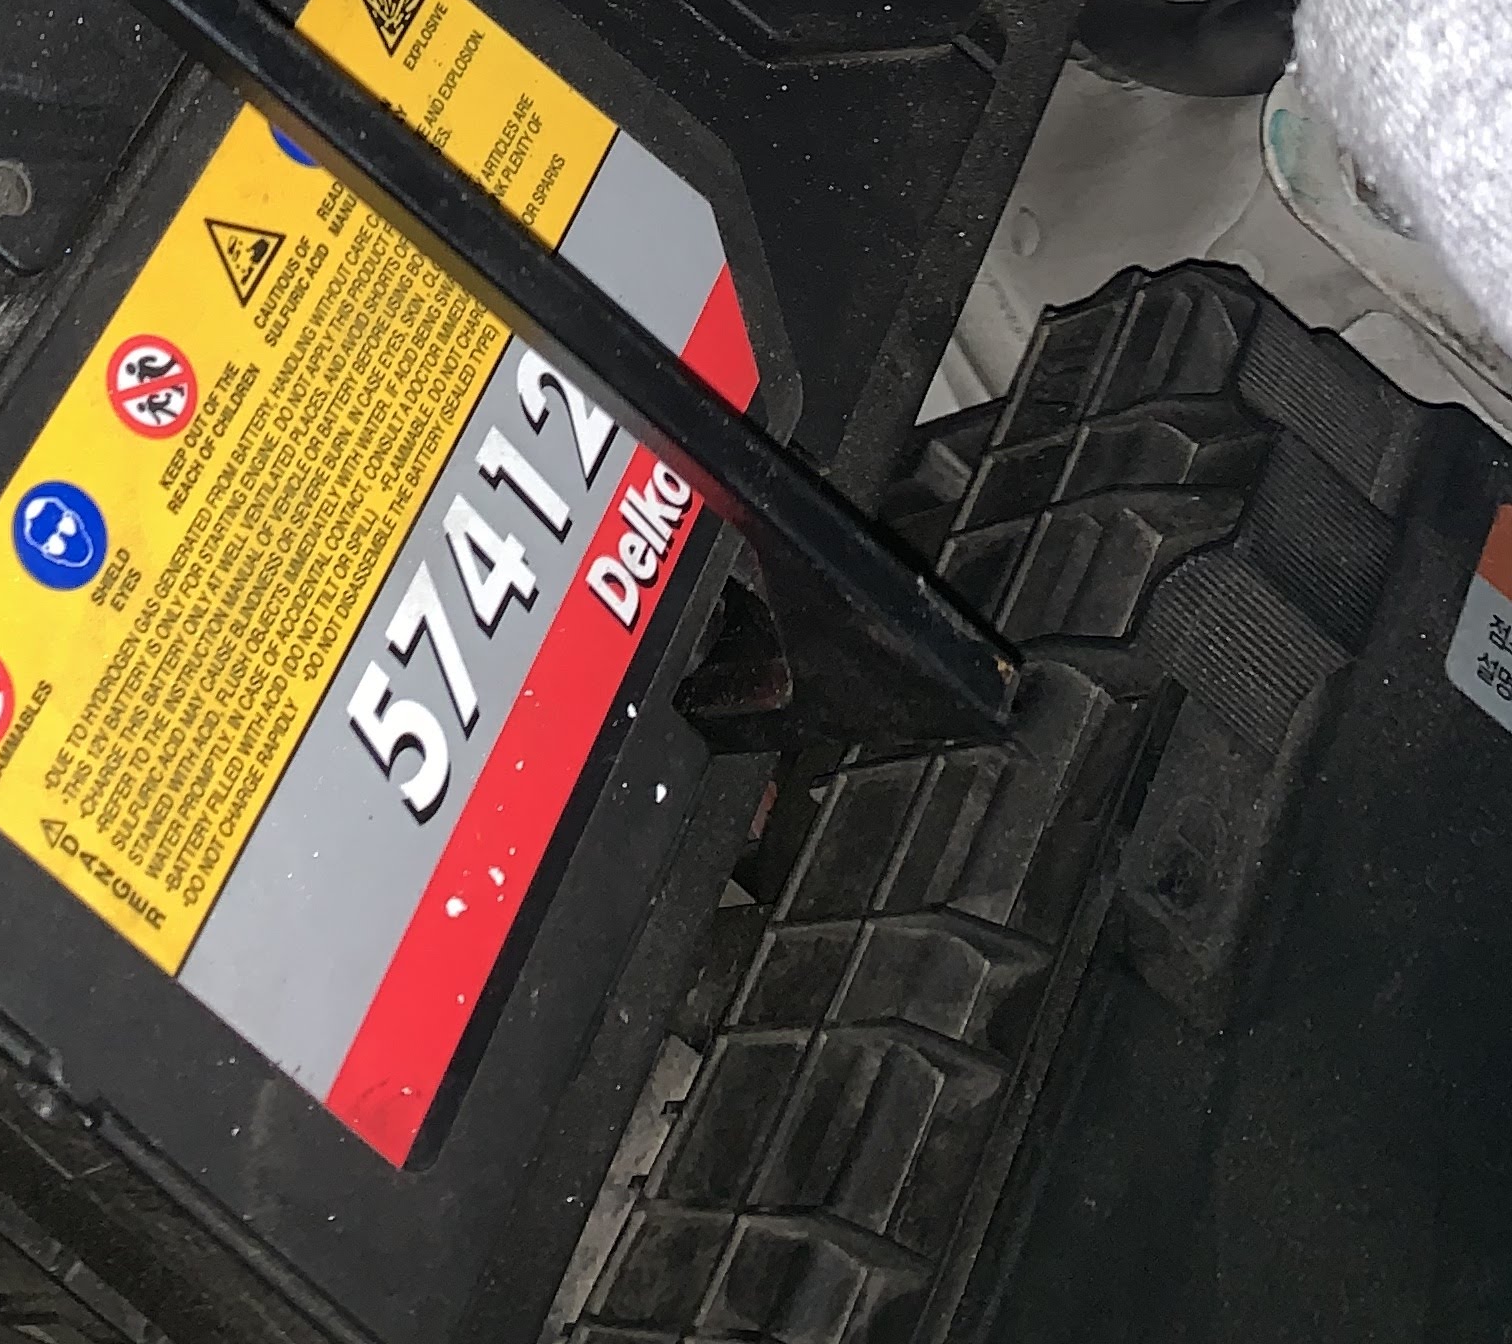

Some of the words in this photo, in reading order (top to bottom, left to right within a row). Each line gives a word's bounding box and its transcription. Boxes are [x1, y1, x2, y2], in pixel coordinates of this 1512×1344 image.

[402, 0, 449, 72] EXPLOSIVE
[511, 92, 535, 124] ARE
[526, 111, 546, 137] OF
[479, 118, 520, 183] ARTICLES
[500, 130, 535, 184] PLENTY
[251, 254, 302, 331] CAUTIOUS
[292, 233, 313, 260] OF
[262, 275, 312, 350] SULFURIC
[302, 240, 331, 281] ACID
[346, 233, 391, 303] PRODUCT
[425, 375, 448, 405] DO
[438, 346, 464, 381] NOT
[531, 151, 567, 207] SPARKS
[328, 297, 356, 335] THIS
[410, 302, 443, 351] BEING
[303, 328, 338, 379] APPLY
[392, 344, 420, 385] ACID
[65, 721, 89, 750] TO
[79, 628, 142, 727] HYDROGEN
[131, 593, 162, 636] GAS
[151, 503, 214, 601] GENERATED
[204, 460, 238, 510] FROM
[267, 323, 317, 400] HANDLING
[308, 261, 353, 328] WITHOUT
[342, 221, 375, 268] CARE
[421, 95, 446, 128] AND
[436, 25, 486, 101] EXPLOSION.
[272, 403, 295, 433] DO
[286, 372, 313, 409] NOT
[346, 403, 365, 426] IN
[355, 364, 387, 410] CASE
[384, 378, 402, 399] IF
[156, 445, 190, 492] KEEP
[181, 412, 209, 451] OUT
[200, 389, 223, 418] OF
[213, 359, 240, 395] THE
[165, 457, 206, 517] REACH
[196, 434, 219, 463] OF
[209, 360, 262, 441] CHILDREN
[118, 703, 150, 746] THIS
[140, 632, 190, 708] BATTERY
[180, 590, 214, 637] ONLY
[203, 569, 225, 597] AT
[215, 527, 249, 576] WELL
[238, 441, 297, 534] VENTILATED
[321, 351, 348, 389] AND
[338, 309, 372, 358] AVOID
[361, 255, 401, 316] SHORTS
[288, 465, 331, 531] SEVERE
[315, 614, 344, 655] NOT
[333, 513, 398, 621] DISASSEMBLE
[388, 482, 414, 519] THE
[404, 419, 448, 489] BATTERY
[437, 362, 479, 427] (SEALED
[469, 320, 501, 368] TYPE)
[333, 447, 364, 492] WITH
[128, 743, 152, 774] TO
[142, 709, 171, 748] THE
[161, 604, 229, 715] INSTRUCTION
[219, 541, 265, 611] MANUAL
[254, 519, 277, 549] OF
[267, 457, 312, 525] VEHICLE
[302, 433, 325, 464] OR
[315, 372, 359, 440] BATTERY
[350, 313, 392, 377] BEFORE
[381, 271, 415, 320] USING
[196, 487, 248, 567] STARTING
[274, 524, 298, 556] OR
[281, 484, 344, 586] IMMEDIATELY
[586, 459, 693, 632] Delko
[88, 545, 132, 608] SHIELD
[108, 564, 144, 614] EYES
[177, 559, 206, 600] FOR
[227, 549, 284, 640] BLINDNESS
[349, 348, 616, 823] 57412
[143, 817, 186, 883] WATER
[225, 708, 245, 732] IN
[235, 662, 270, 713] CASE
[260, 638, 283, 669] OF
[273, 546, 333, 645] ACCIDENTAL
[361, 410, 407, 483] CONSULT
[403, 341, 444, 406] DOCTOR
[153, 594, 187, 642] ONLY
[243, 579, 292, 656] OBJECTS
[143, 635, 164, 660] IS
[196, 633, 238, 696] CAUSE
[204, 752, 246, 816] FILLED
[235, 710, 268, 759] WITH
[258, 673, 288, 717] ACID
[279, 640, 307, 678] (DO
[295, 606, 324, 647] NOT
[314, 575, 341, 612] TILT
[330, 550, 354, 582] OR
[344, 505, 381, 559] SPILL)
[214, 650, 253, 708] FLUSH
[102, 653, 153, 732] BATTERY
[177, 689, 207, 730] MAY
[85, 725, 113, 761] 12V
[154, 724, 187, 771] ACID
[165, 746, 200, 797] WITH
[108, 766, 164, 854] SULFURIC
[196, 833, 227, 878] NOT
[216, 762, 265, 840] CHARGE
[254, 695, 301, 769] RAPIDLY
[126, 791, 176, 868] STAINED
